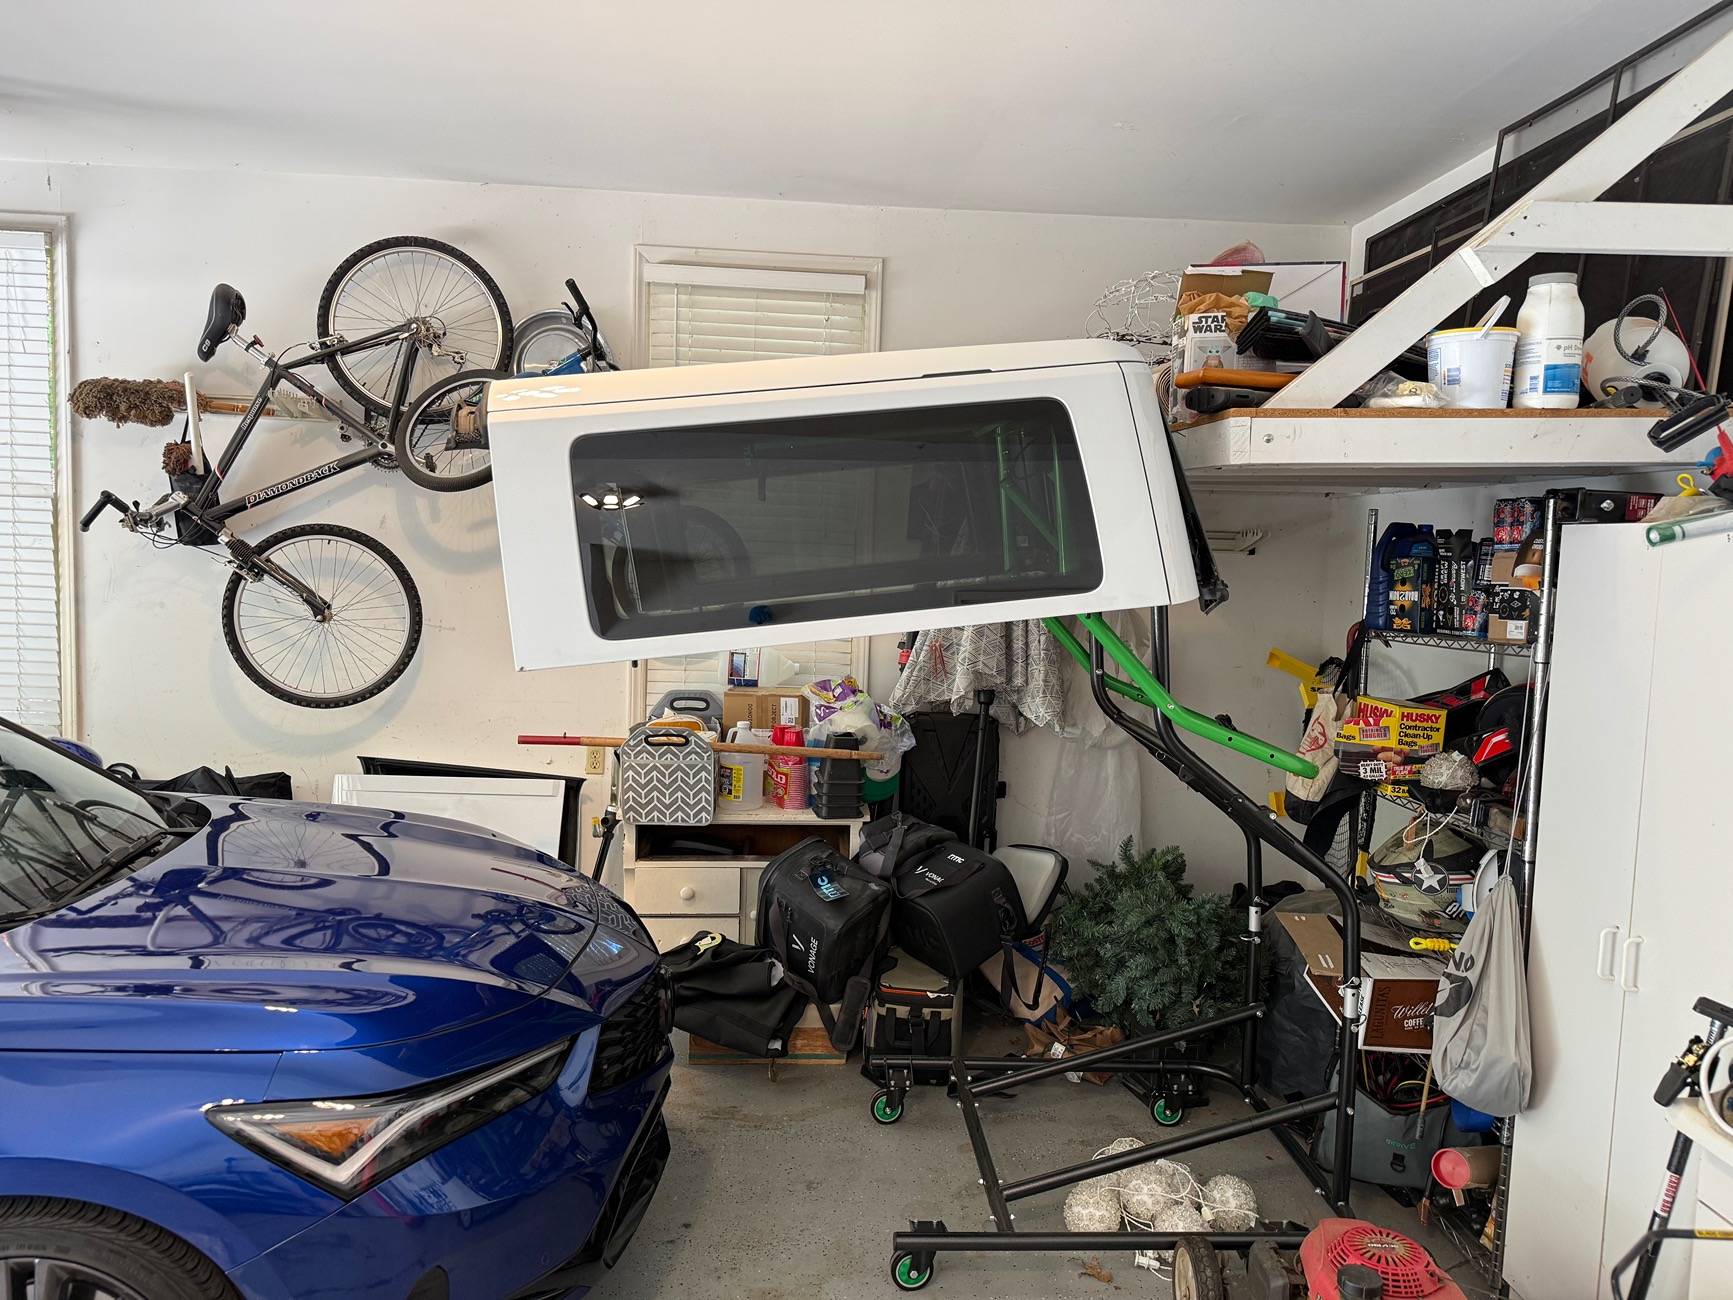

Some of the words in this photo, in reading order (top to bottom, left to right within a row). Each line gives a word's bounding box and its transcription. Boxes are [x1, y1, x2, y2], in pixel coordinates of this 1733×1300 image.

[1192, 324, 1226, 334] WAR
[245, 461, 341, 508] DIAMONDBACK
[1400, 711, 1442, 724] HUSKY
[1399, 722, 1441, 733] Contractor
[1337, 732, 1356, 741] Bags
[1398, 731, 1433, 741] Clean-Up
[1397, 739, 1418, 748] Bags
[1362, 767, 1368, 775] 3
[1369, 767, 1384, 775] MIL
[1391, 786, 1402, 794] 32
[807, 937, 819, 974] VONAGE
[1403, 1017, 1425, 1027] COFFE
